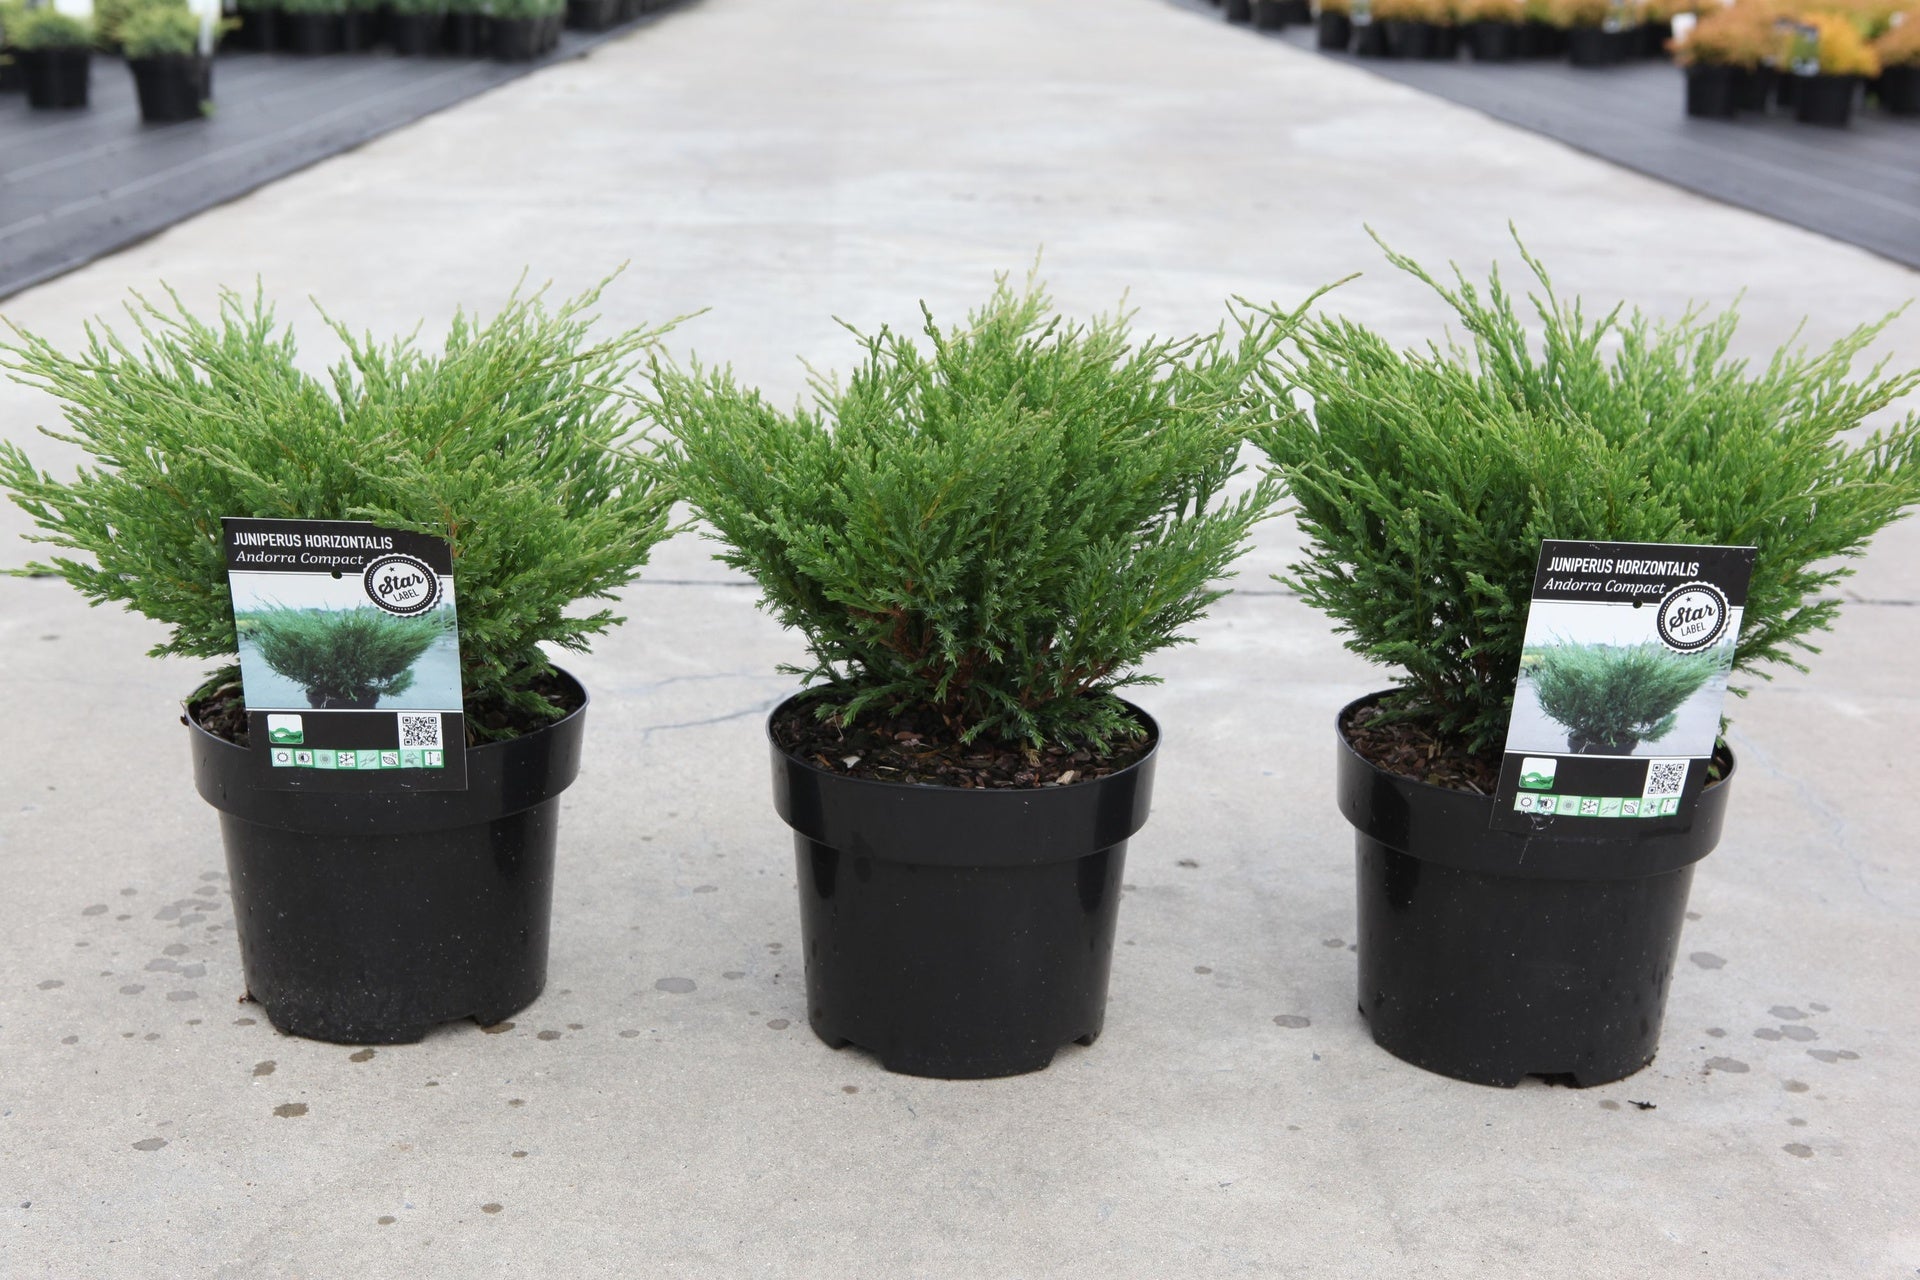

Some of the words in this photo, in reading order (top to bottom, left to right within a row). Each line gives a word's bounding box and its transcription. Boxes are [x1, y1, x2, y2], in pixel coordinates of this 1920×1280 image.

[233, 532, 301, 547] JUNIPERUS
[305, 534, 393, 550] HORIZONTALIS
[235, 550, 296, 563] Andorra
[300, 552, 364, 567] Compact
[1547, 556, 1613, 573] JUNIPERUS
[1615, 559, 1699, 577] HORIZONTALIS
[378, 573, 424, 598] Star
[1543, 577, 1602, 592] Andorra
[1605, 580, 1666, 596] Compact
[393, 588, 420, 602] LABEL
[1669, 604, 1716, 632] Star
[1680, 622, 1706, 637] LABEL
